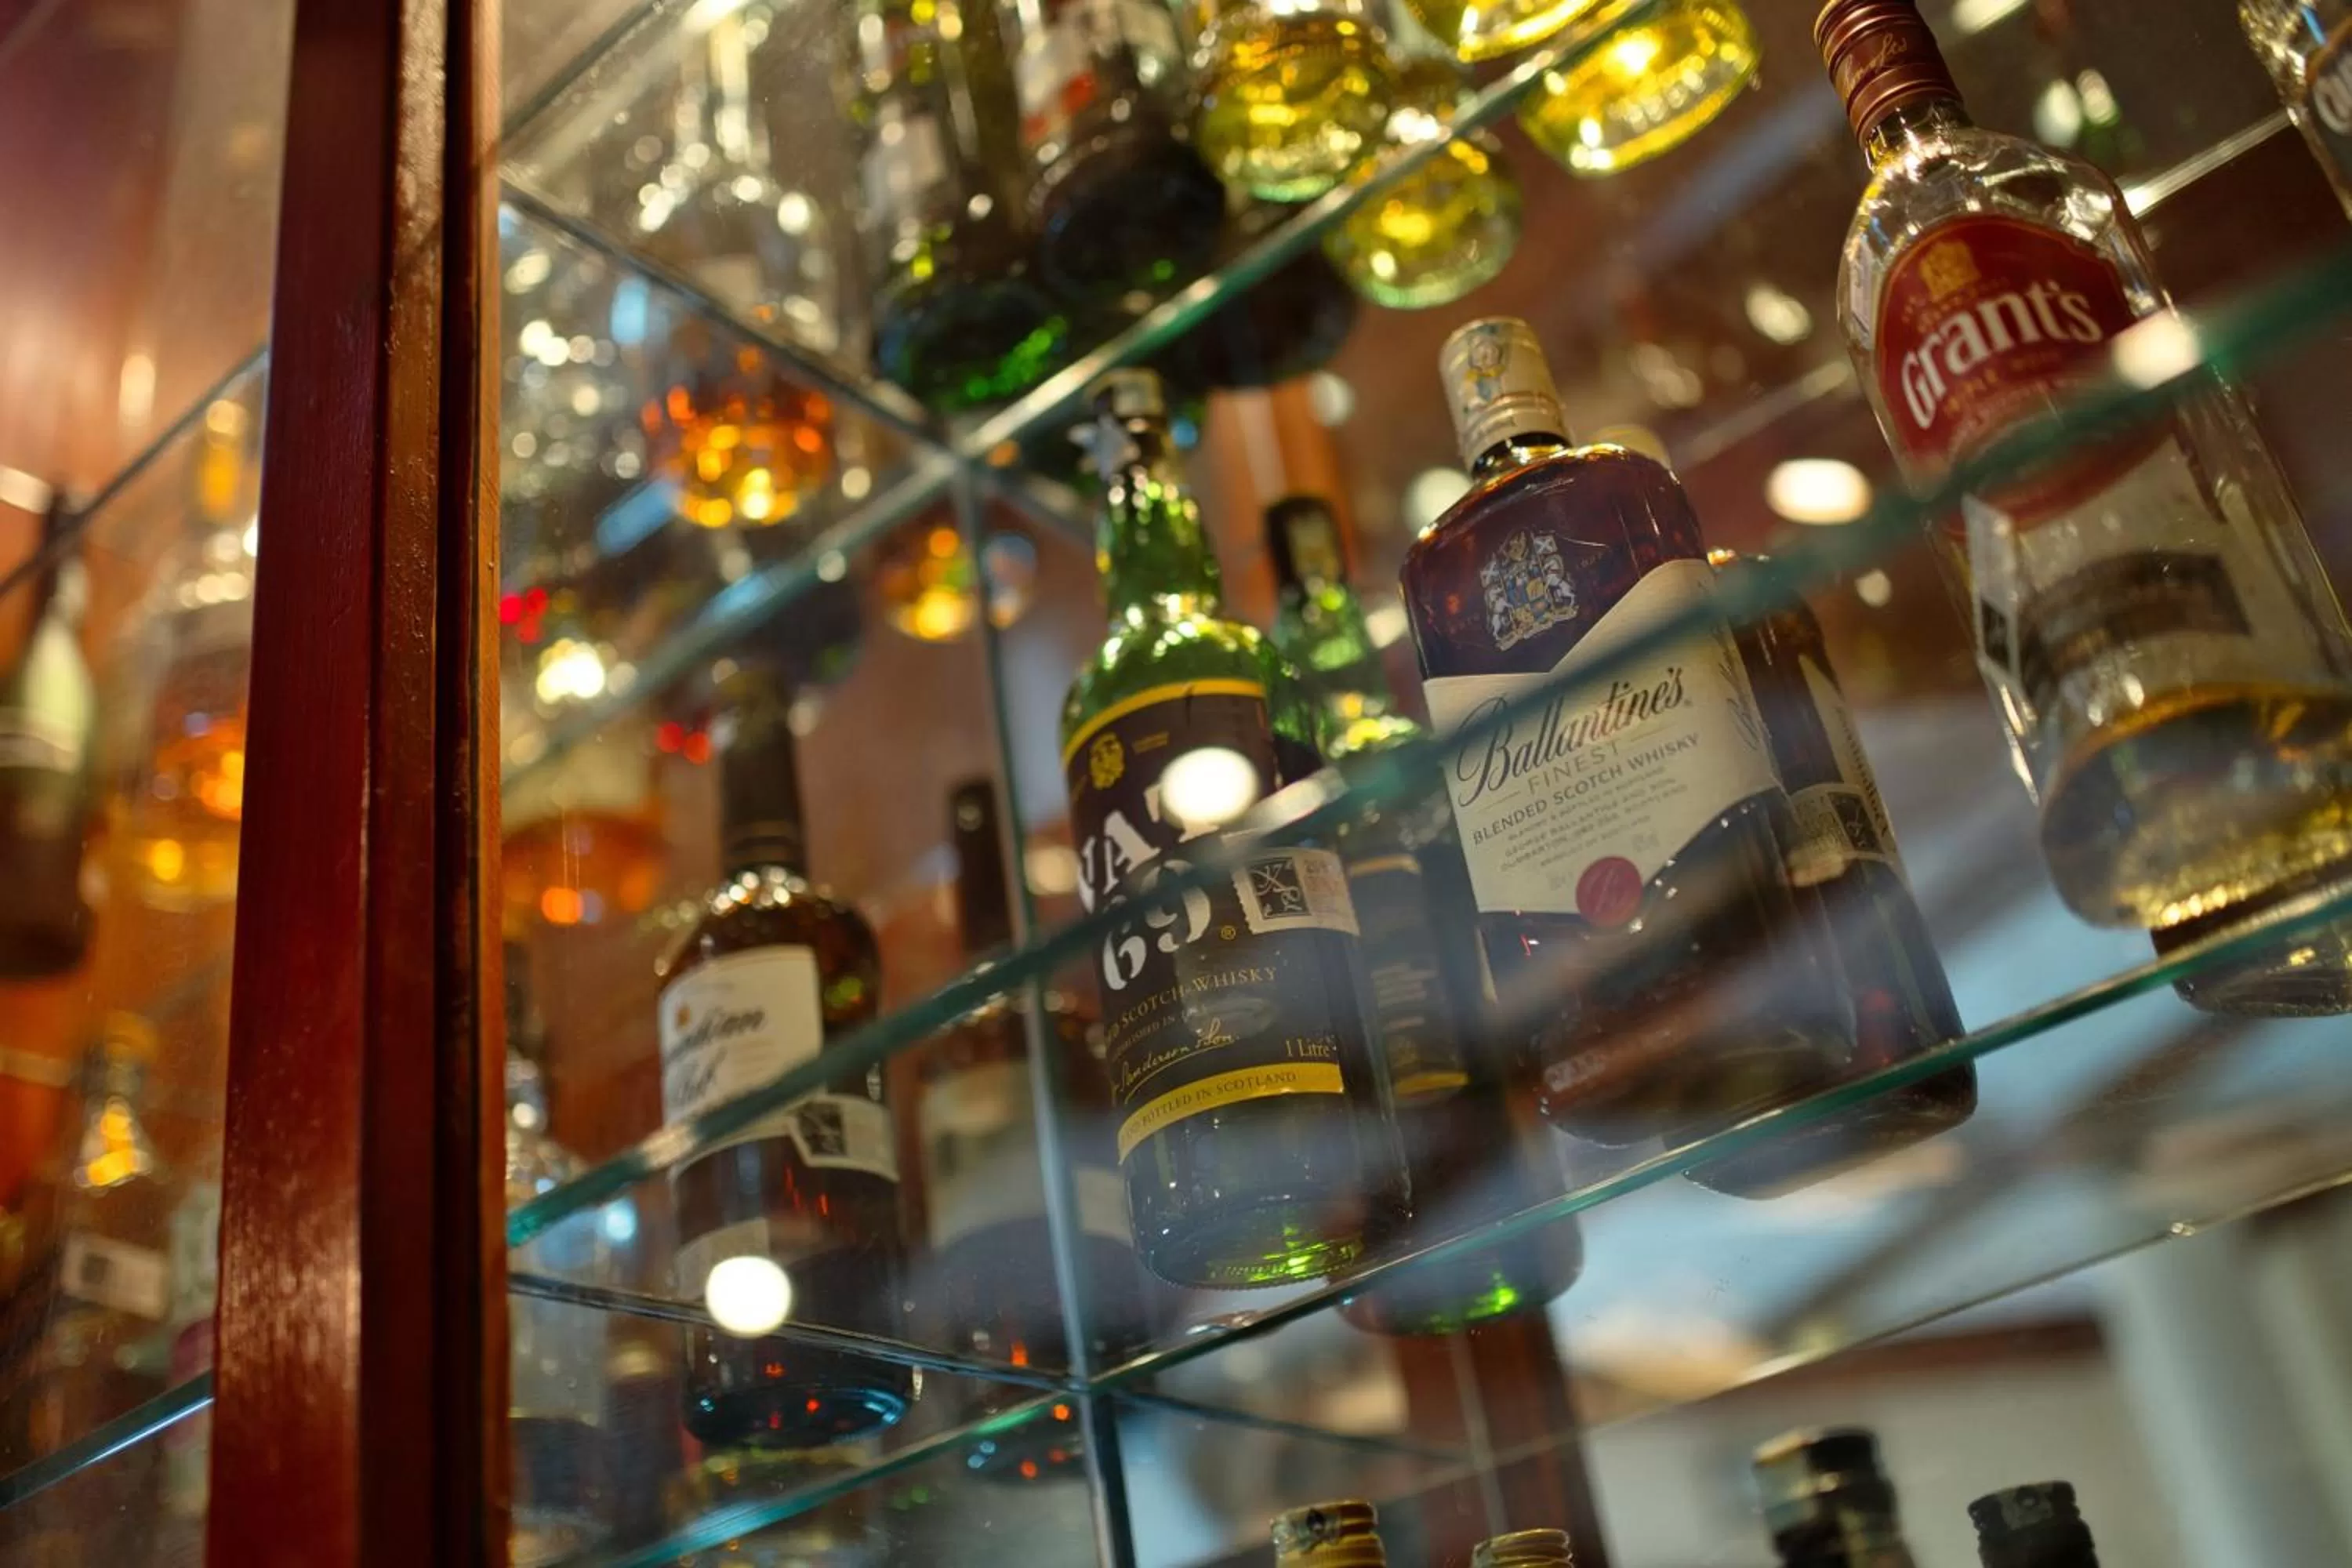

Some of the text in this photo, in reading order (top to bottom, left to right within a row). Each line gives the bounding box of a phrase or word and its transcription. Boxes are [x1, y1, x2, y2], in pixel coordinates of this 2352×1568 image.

[1900, 279, 2103, 430] Grant's
[1457, 667, 1684, 808] Ballantine's
[1472, 799, 1548, 845] BLENDED
[1552, 764, 1623, 805] SCOTCH
[1627, 731, 1700, 771] WHISKY
[1528, 740, 1621, 795] FINEST
[1102, 859, 1212, 991] 69
[1120, 966, 1277, 1027] SCOTCH WHISKY
[1215, 1071, 1298, 1095] SCOTLAND
